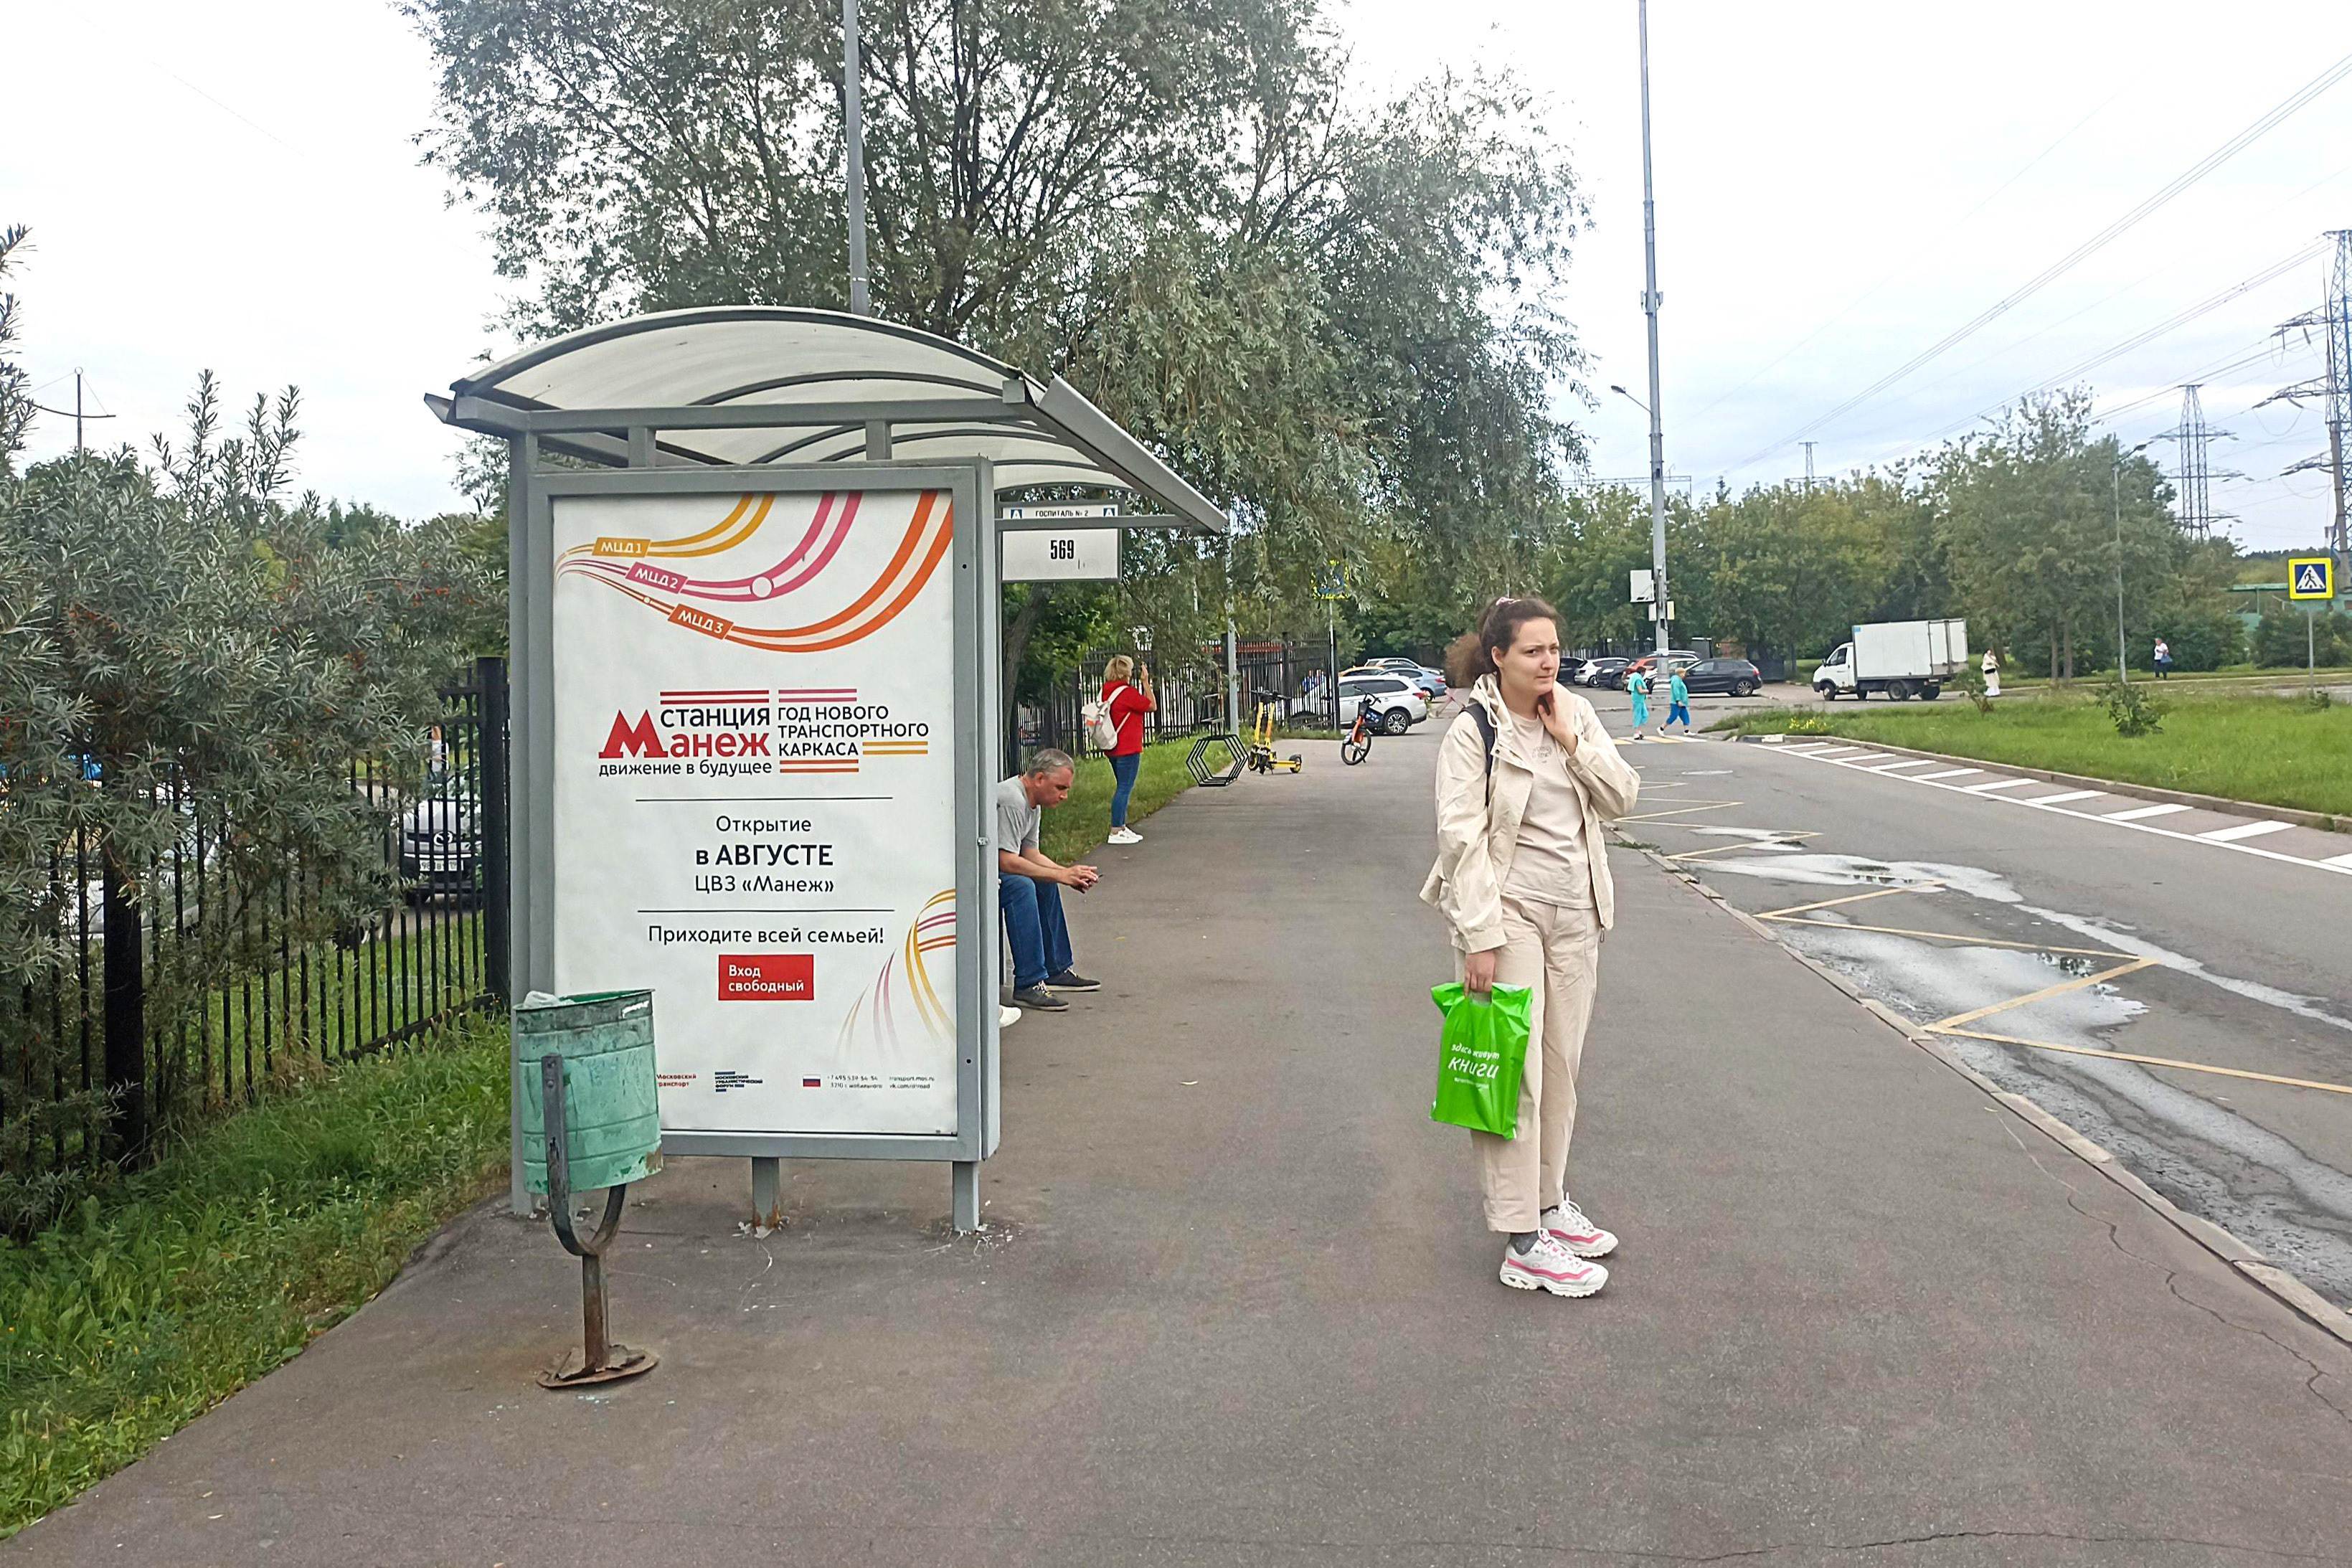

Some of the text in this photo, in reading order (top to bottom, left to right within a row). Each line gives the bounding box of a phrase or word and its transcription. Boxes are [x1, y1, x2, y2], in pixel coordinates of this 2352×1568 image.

[1050, 539, 1075, 559] 569
[778, 706, 889, 722] ГОД НОВОГО
[598, 709, 771, 759] Манеж
[778, 723, 930, 738] ТРАНСПОРТНОГО
[778, 742, 859, 756] КАРКАСА
[598, 760, 773, 778] движение в будущее
[716, 815, 812, 836] Открытие
[696, 844, 833, 866] в АВГУСТЕ
[695, 875, 834, 894] ЦВЗ «Манеж»
[648, 925, 884, 945] Приходите всей семьей!
[728, 964, 761, 978] Вход
[728, 979, 804, 993] свободный
